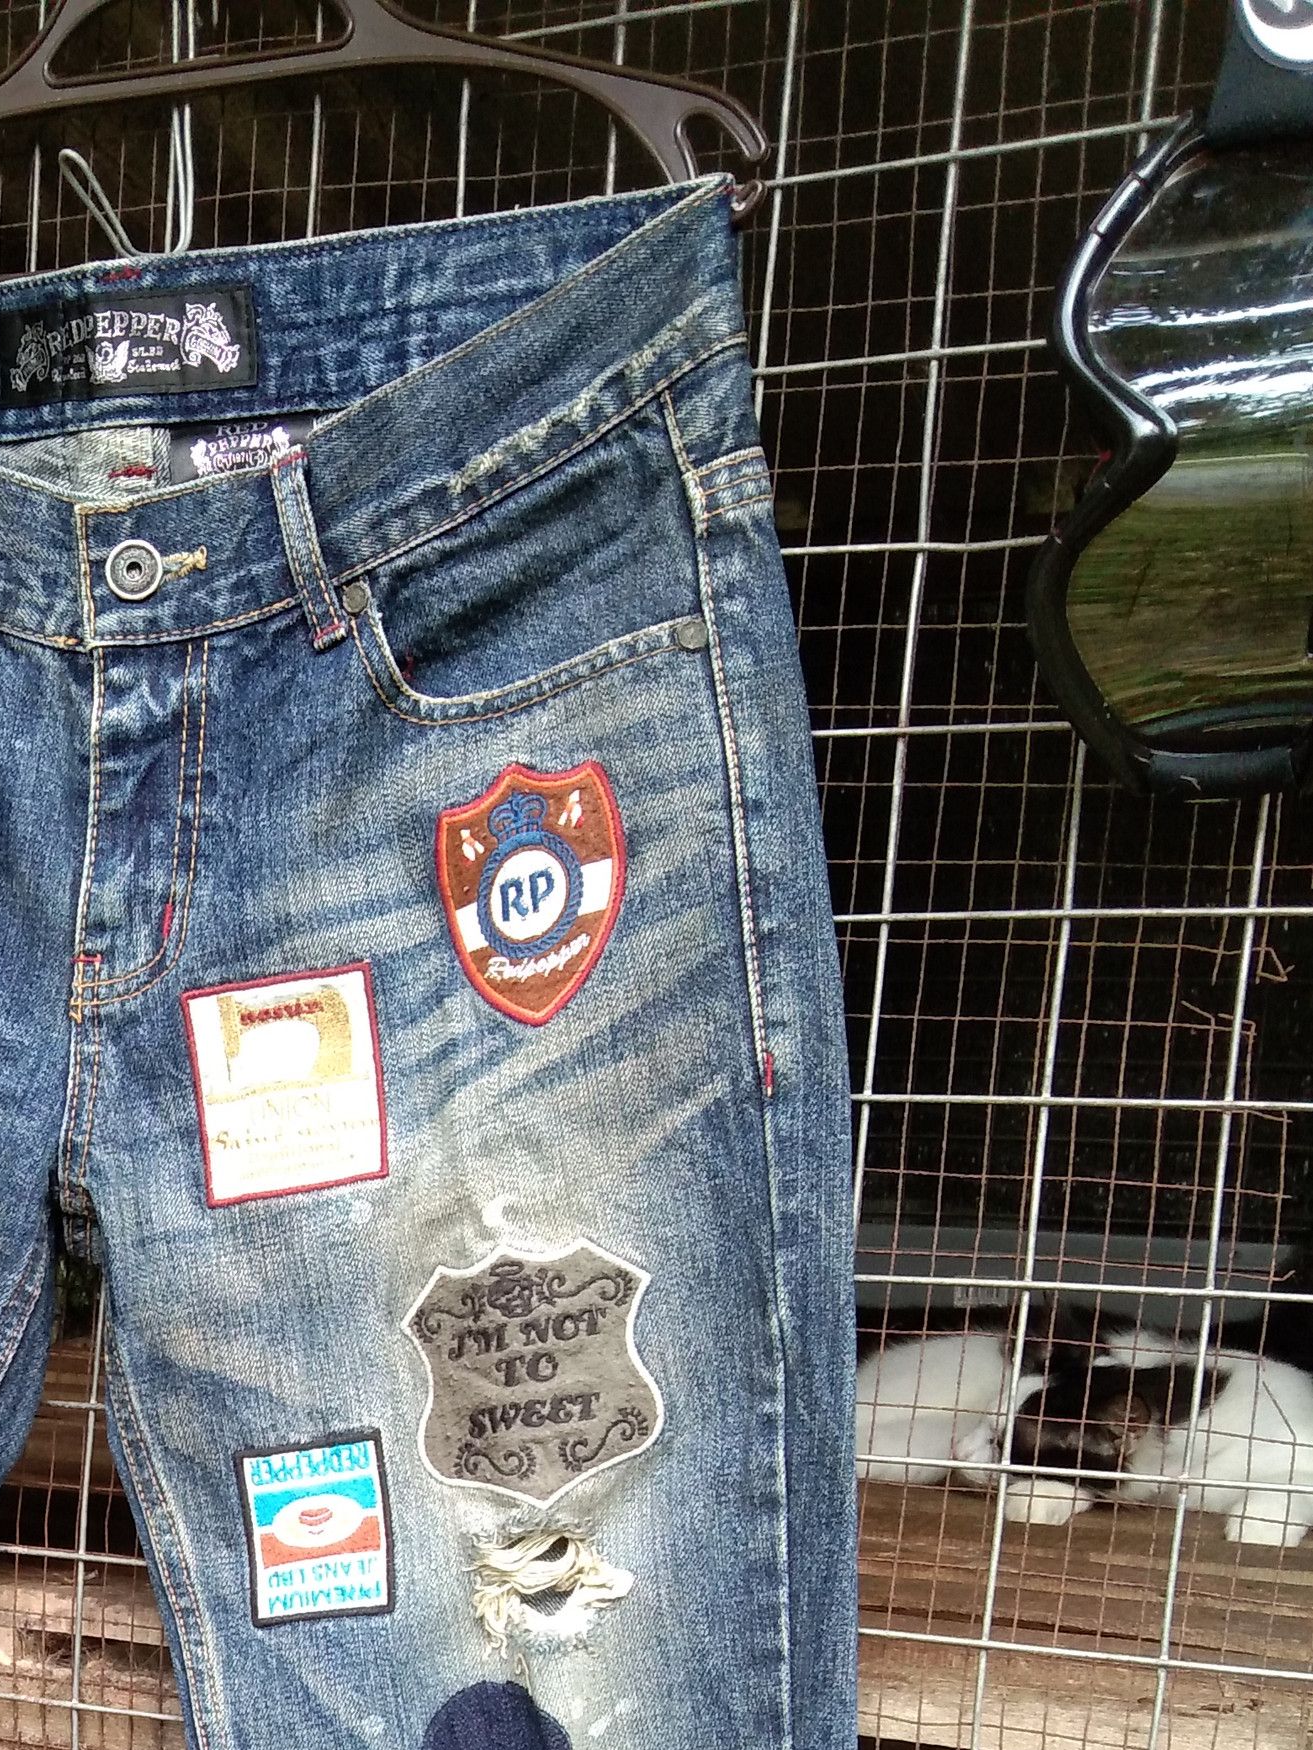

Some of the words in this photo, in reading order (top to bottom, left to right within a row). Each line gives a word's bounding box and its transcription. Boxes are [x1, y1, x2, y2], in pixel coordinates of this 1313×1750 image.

[46, 310, 182, 358] REDPEPPER
[499, 866, 555, 922] RP
[519, 1304, 608, 1347] NOT
[495, 1352, 559, 1387] TO
[469, 1392, 601, 1439] SWEET
[251, 1441, 370, 1486] REDPEPPER
[269, 1580, 382, 1614] PREMIUM
